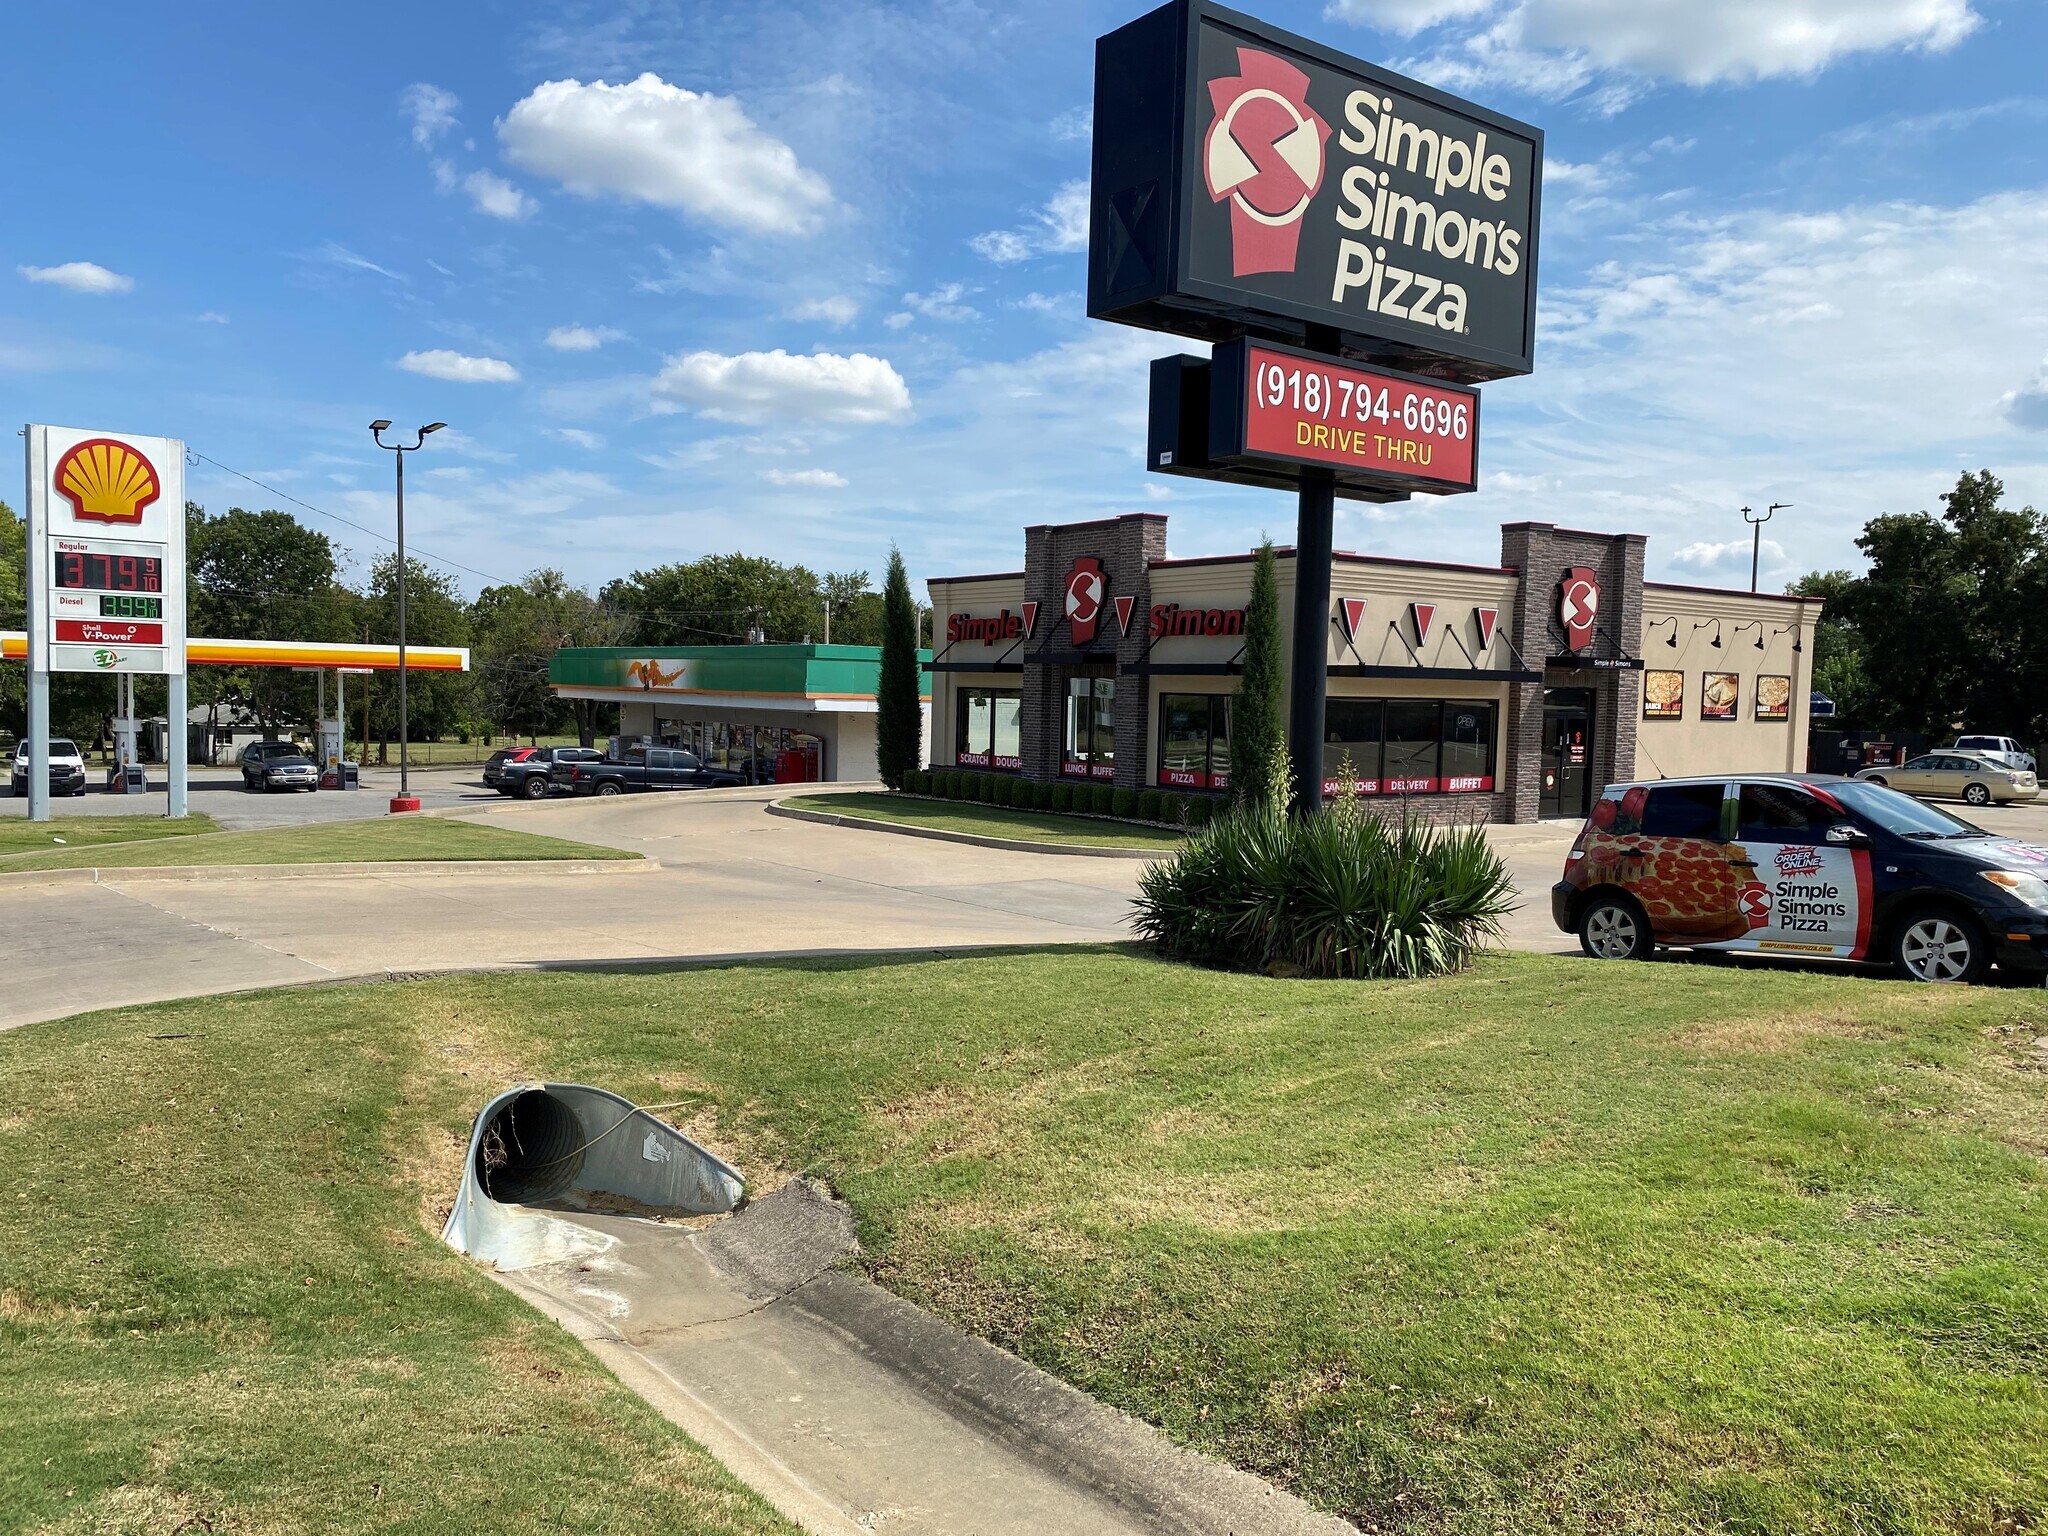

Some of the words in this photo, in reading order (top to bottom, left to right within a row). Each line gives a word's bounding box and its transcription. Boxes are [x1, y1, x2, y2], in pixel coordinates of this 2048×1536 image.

[1338, 89, 1511, 202] Simple
[1335, 165, 1522, 276] Simon's
[1331, 237, 1469, 334] Pizza
[1256, 361, 1332, 420] (918)
[1337, 378, 1469, 441] 794-6696
[1296, 420, 1367, 455] DRIVE
[1373, 434, 1433, 466] THRU
[58, 541, 89, 552] Regular
[59, 596, 83, 606] Diesel
[103, 596, 148, 618] 3.99
[82, 624, 101, 632] Shell
[946, 608, 1022, 647] Simple
[82, 631, 133, 641] V-Power
[93, 652, 114, 665] EZ
[960, 753, 989, 765] SCRATCH
[1065, 763, 1087, 774] LUNCH
[1170, 772, 1195, 784] PIZZA
[1449, 777, 1483, 790] BUFFET
[1390, 779, 1430, 791] DELIVERY
[1775, 851, 1812, 864] ORDER
[1782, 857, 1821, 870] ONLINE
[1775, 881, 1839, 901] Simple
[1777, 898, 1846, 916] Simon's
[1780, 915, 1829, 932] Pizza
[1759, 941, 1834, 953] SIMPLESIMONSPIZZA.COM
